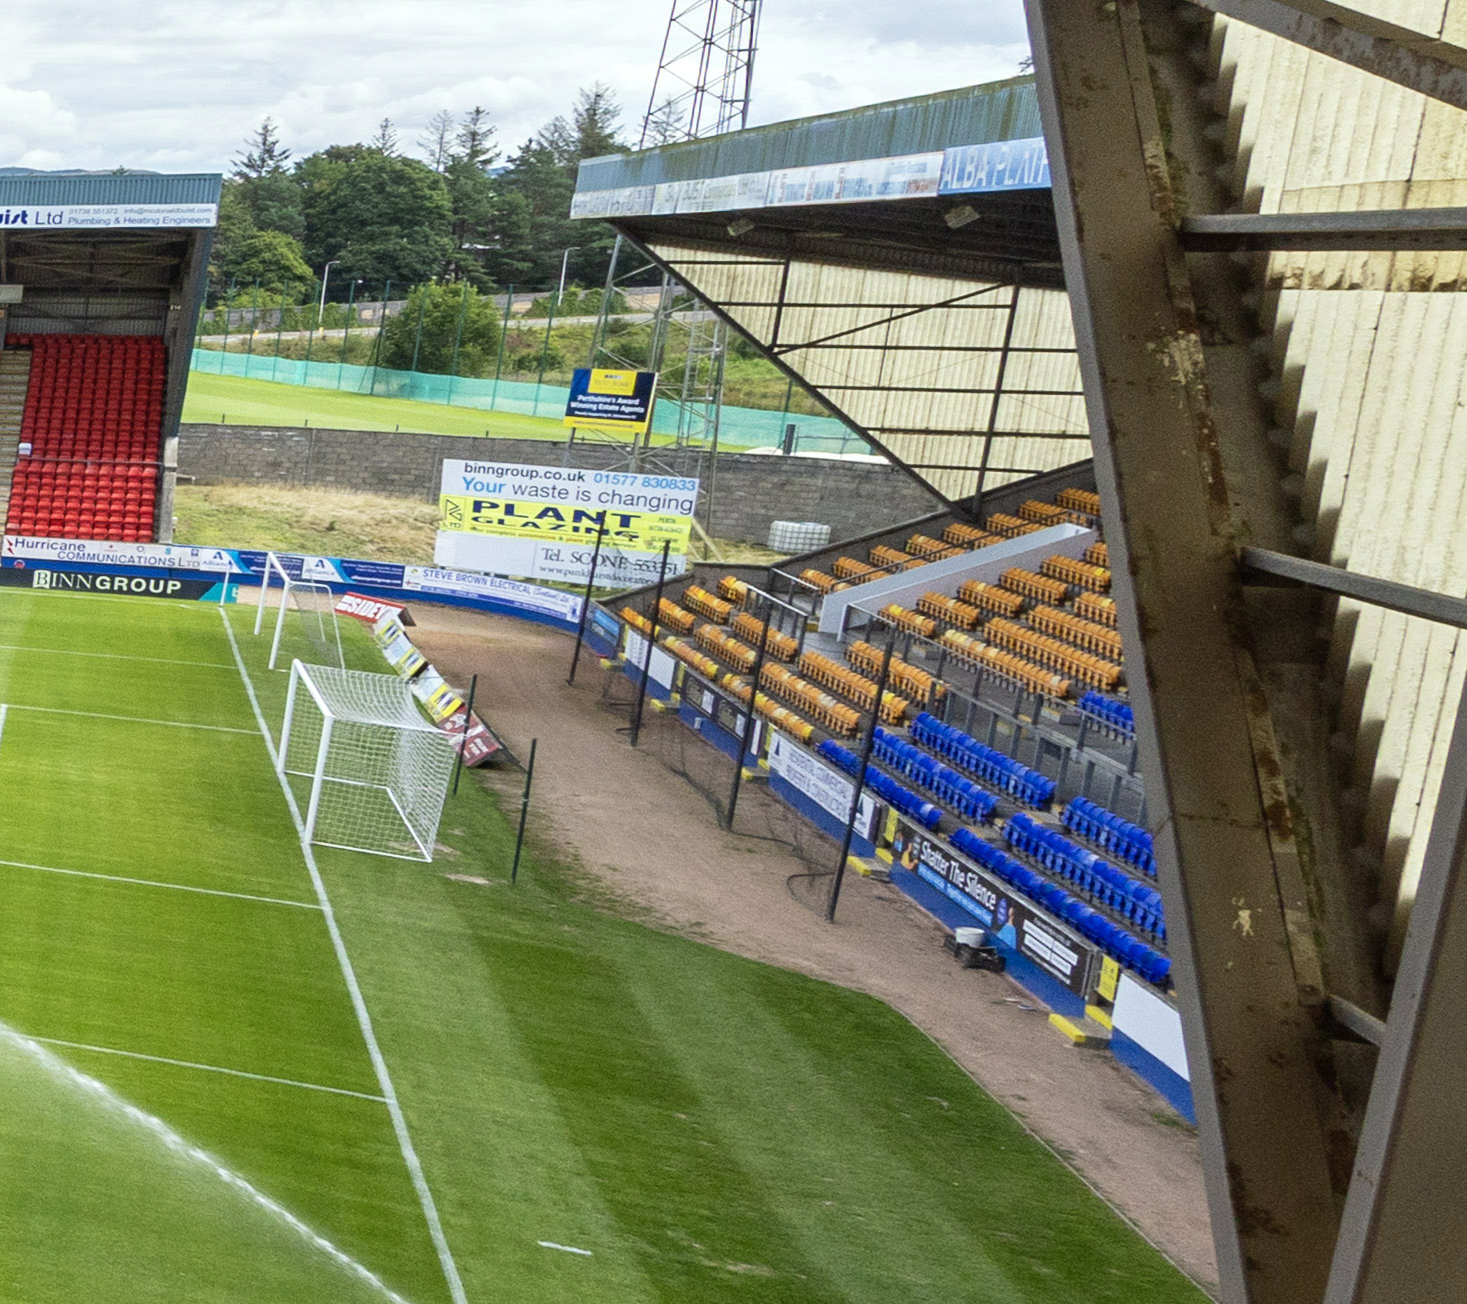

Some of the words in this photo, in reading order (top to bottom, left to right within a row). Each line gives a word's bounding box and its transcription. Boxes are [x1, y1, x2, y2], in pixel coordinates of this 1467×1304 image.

[35, 211, 63, 225] Ltd
[68, 216, 111, 225] Plumbing
[123, 216, 160, 225] Heating
[162, 216, 210, 225] Engineers
[464, 462, 586, 483] binngroup.co.uk
[593, 471, 638, 487] 01577
[641, 476, 696, 492] 830833
[462, 476, 507, 494] Your
[513, 483, 569, 500] waste
[576, 485, 591, 502] is
[598, 488, 694, 515] changing
[472, 499, 642, 529] PLANT
[471, 516, 640, 540] GLAZING
[14, 538, 86, 553] Hurricane
[57, 550, 175, 568] COMMUNICATIONS
[542, 547, 564, 562] Tel.
[570, 551, 628, 570] SCONE
[422, 568, 453, 581] STEVE
[455, 574, 487, 586] BROWN
[490, 578, 531, 594] ELECTRICAL
[920, 840, 949, 876] Shatter
[948, 859, 965, 890] The
[965, 871, 997, 911] Silence
